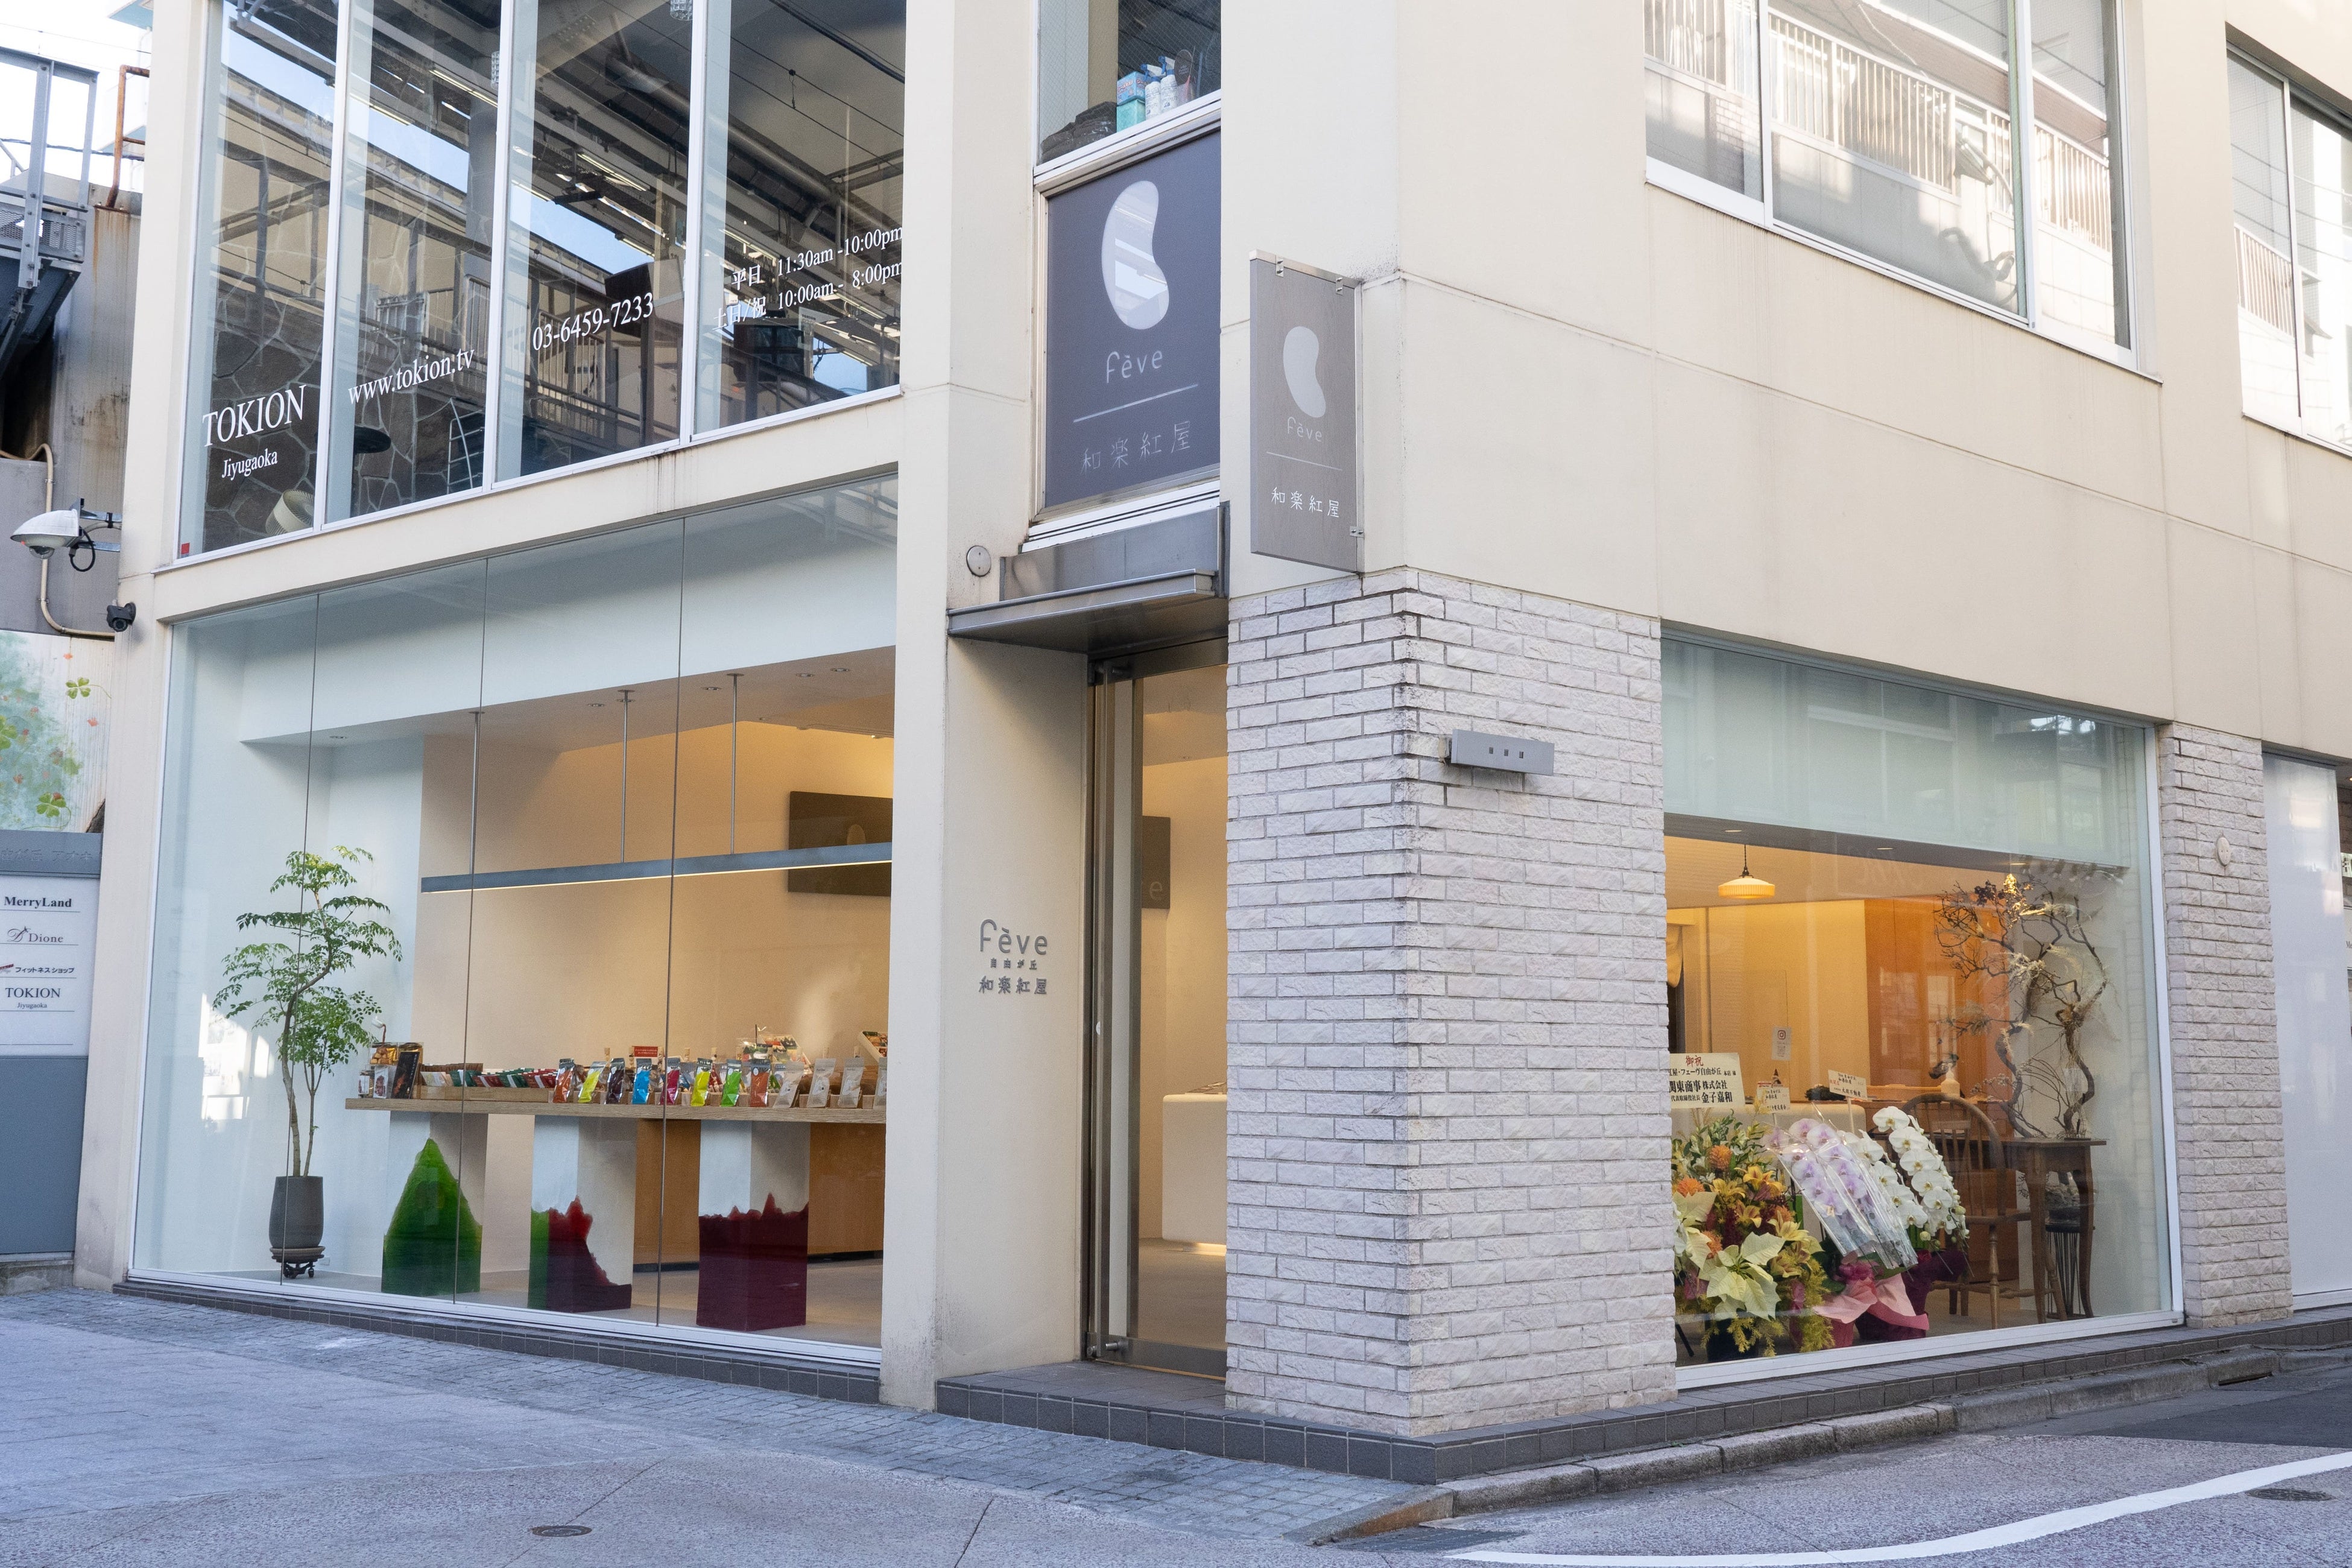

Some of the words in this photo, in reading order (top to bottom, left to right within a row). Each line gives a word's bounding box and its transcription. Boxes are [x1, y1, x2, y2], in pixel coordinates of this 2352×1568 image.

[732, 265, 760, 291] 平日
[778, 248, 833, 276] 11:30am
[533, 292, 654, 350] 03-6459-7233
[348, 348, 475, 405] www.tokion.tv
[1105, 348, 1163, 384] fève
[202, 384, 306, 447] TOKION
[1286, 416, 1323, 443] fève
[1080, 420, 1191, 475] 和楽紅屋
[221, 448, 278, 481] Jiyugaoka
[1271, 486, 1339, 519] 和楽紅屋
[4, 896, 72, 909] MerryLand
[28, 932, 63, 943] Dione
[979, 918, 1048, 955] fève
[5, 987, 61, 998] TOKION
[978, 975, 1048, 995] 和楽紅屋
[1685, 1055, 1704, 1067] 御祝
